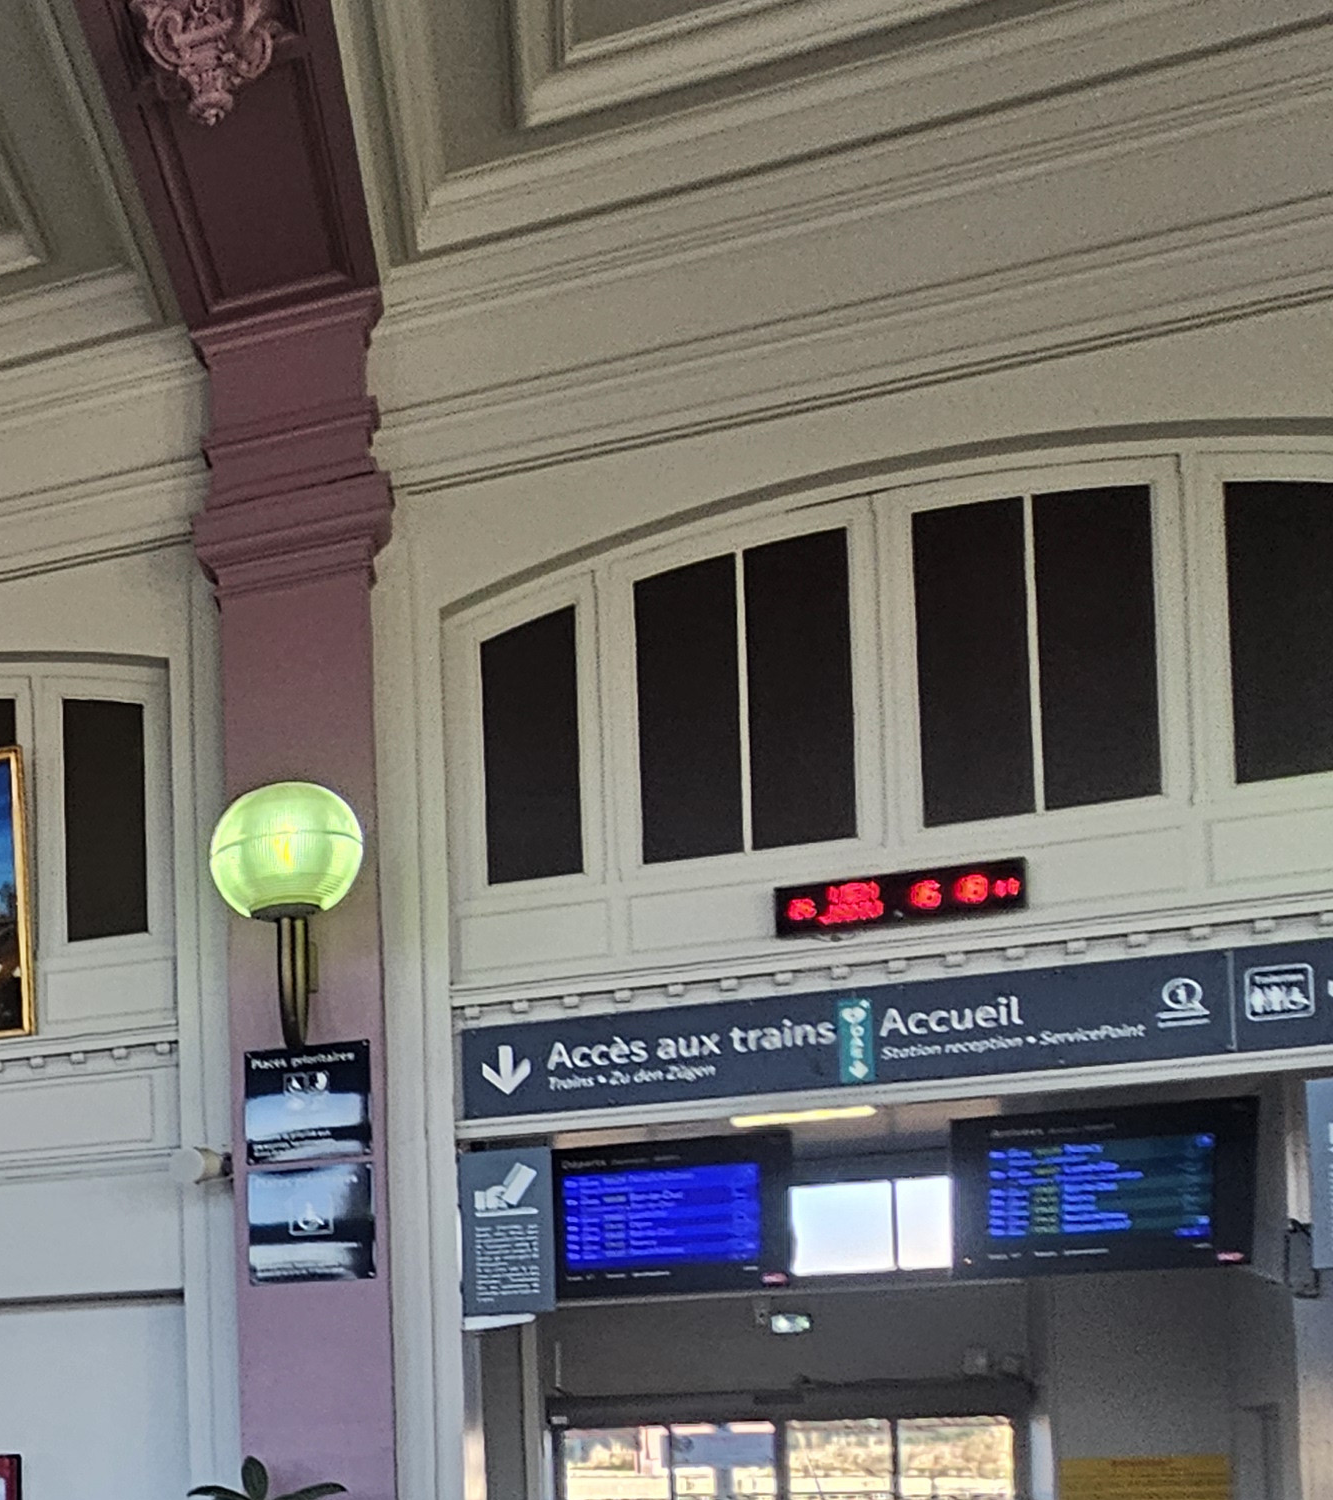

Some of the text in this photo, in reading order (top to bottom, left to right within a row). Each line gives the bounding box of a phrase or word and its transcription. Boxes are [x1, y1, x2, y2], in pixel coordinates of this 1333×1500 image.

[879, 995, 1024, 1037] Accueil
[547, 1036, 649, 1070] Accès
[656, 1033, 722, 1061] aux
[729, 1019, 837, 1053] trains
[881, 1043, 942, 1061] Station
[944, 1035, 1024, 1056] reception
[548, 1075, 595, 1091] Trains
[633, 1067, 664, 1084] den
